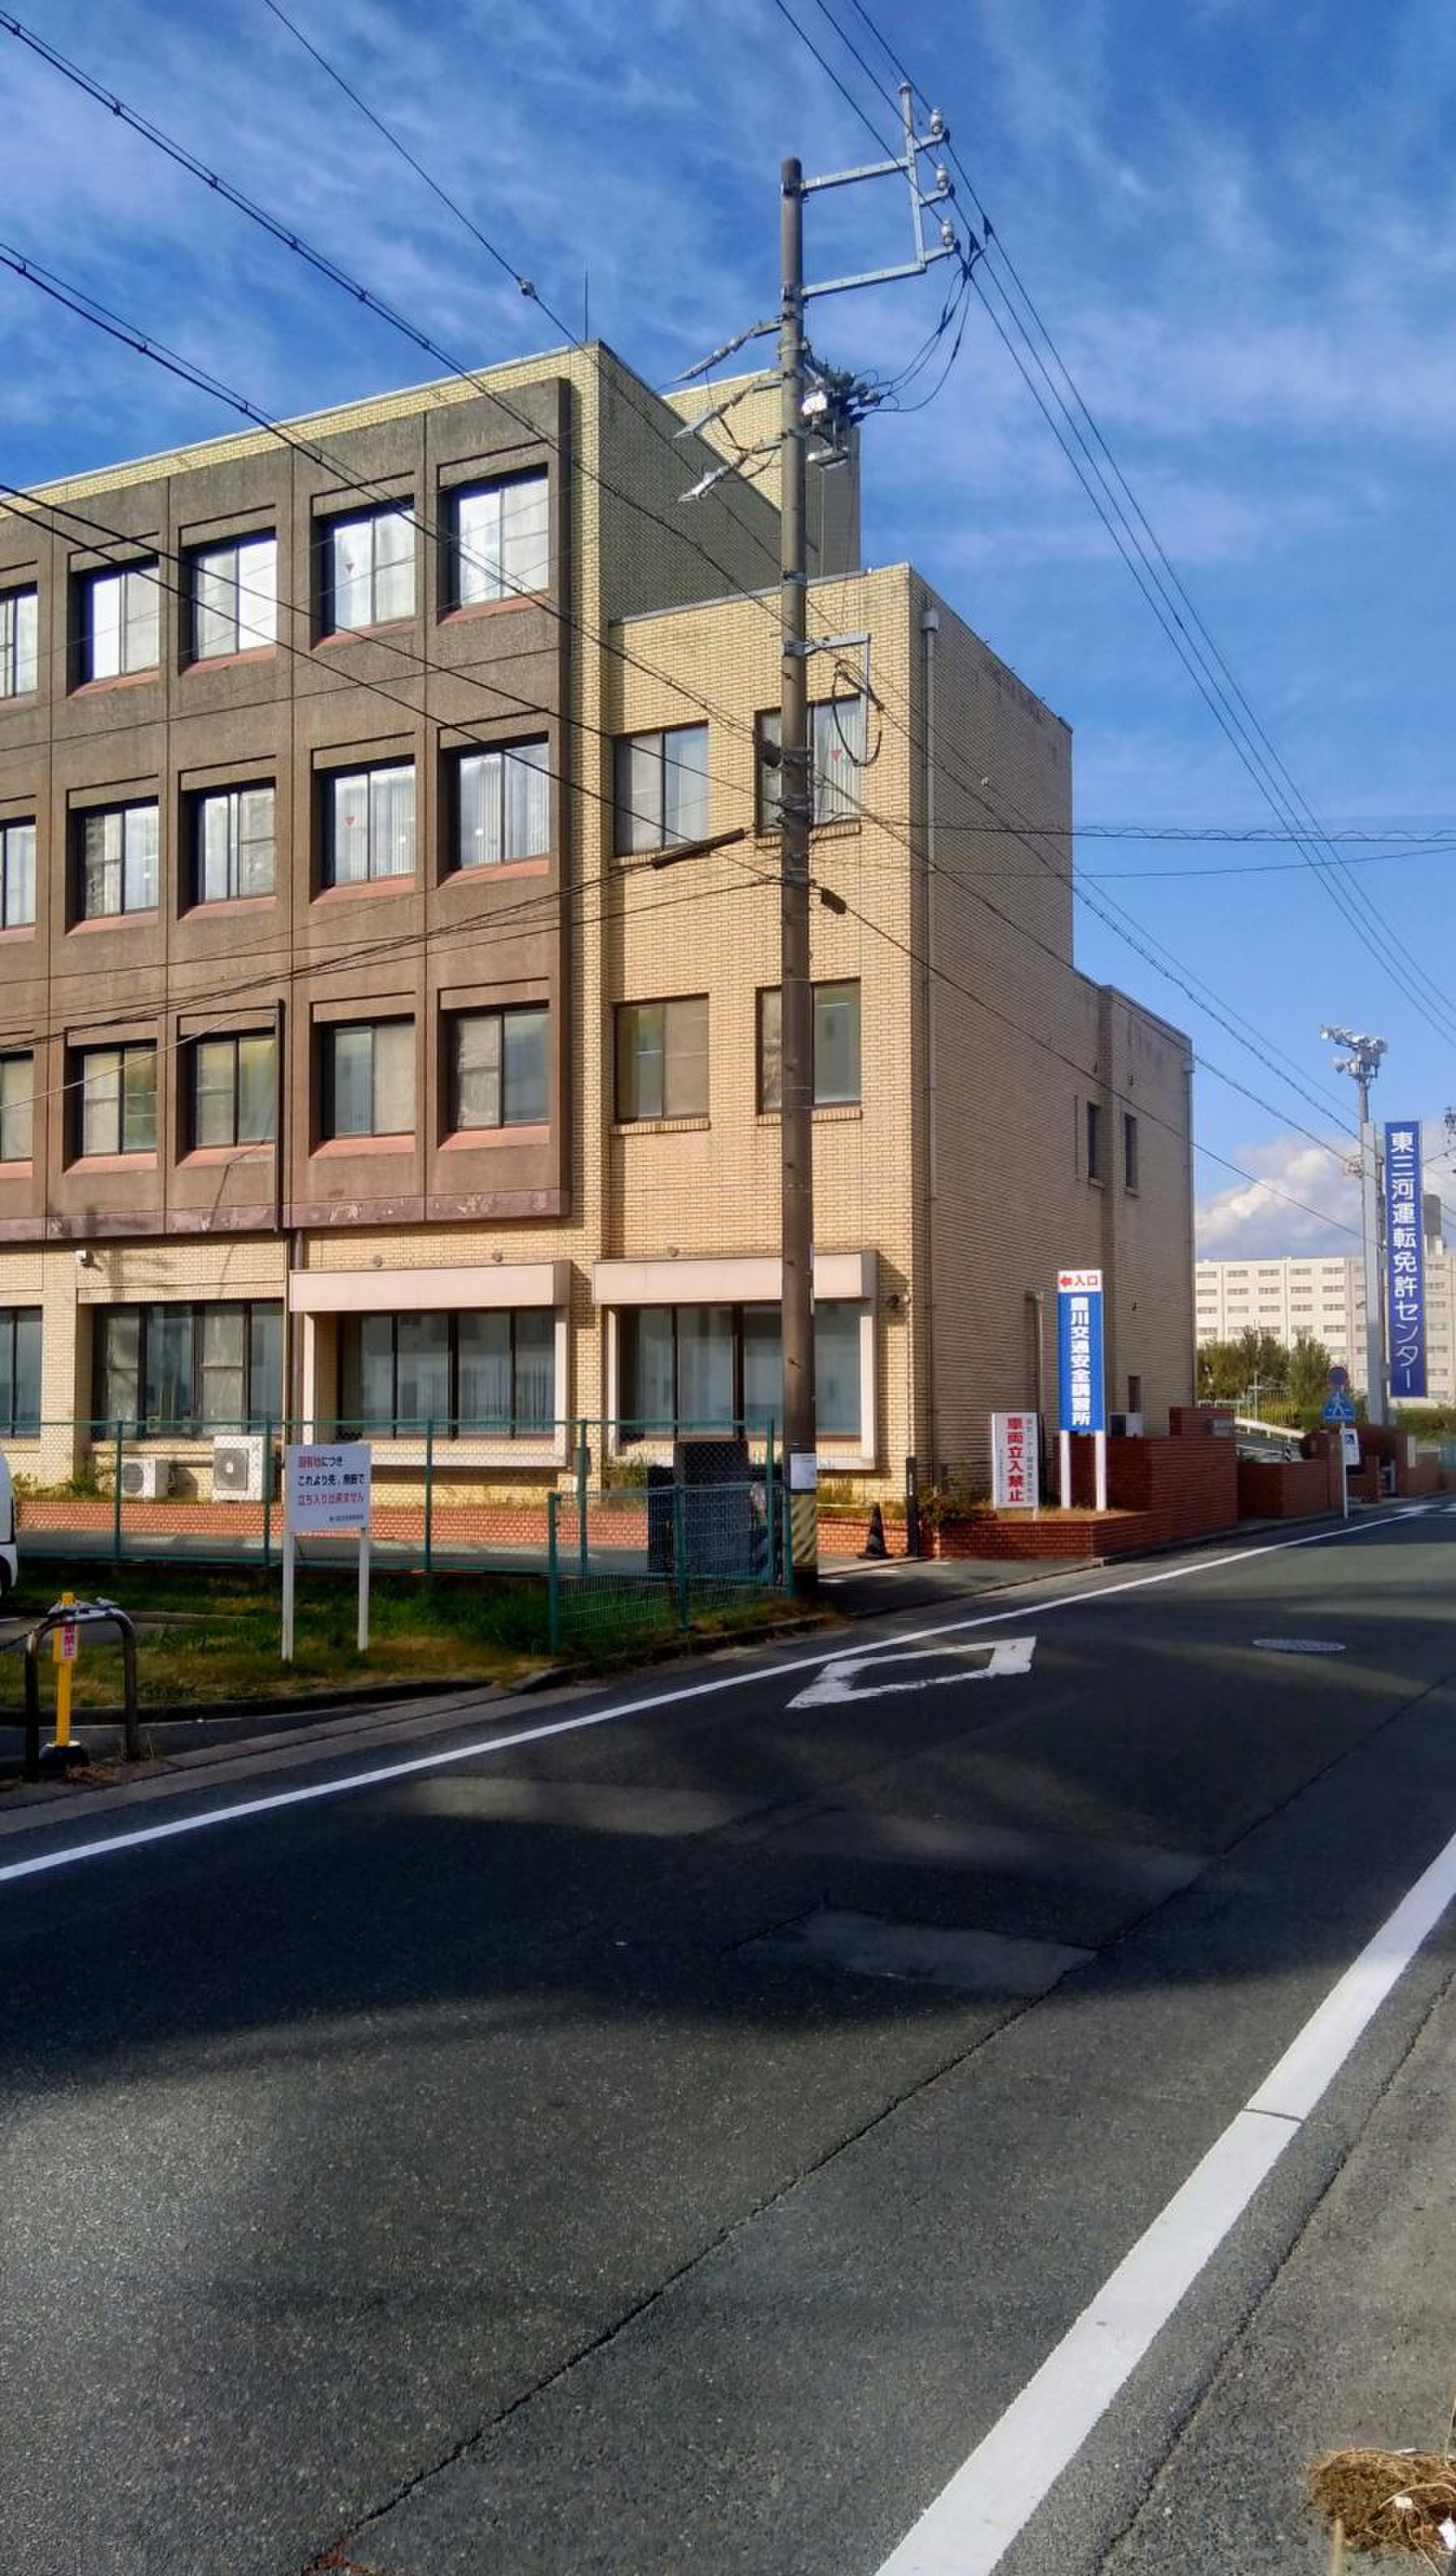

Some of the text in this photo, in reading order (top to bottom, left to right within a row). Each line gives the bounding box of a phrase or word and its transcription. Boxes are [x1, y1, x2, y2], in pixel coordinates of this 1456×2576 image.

[1074, 1276, 1098, 1286] 入口
[1390, 1131, 1419, 1389] 東三河運転免許センター
[1008, 1417, 1025, 1502] 車両立入禁止
